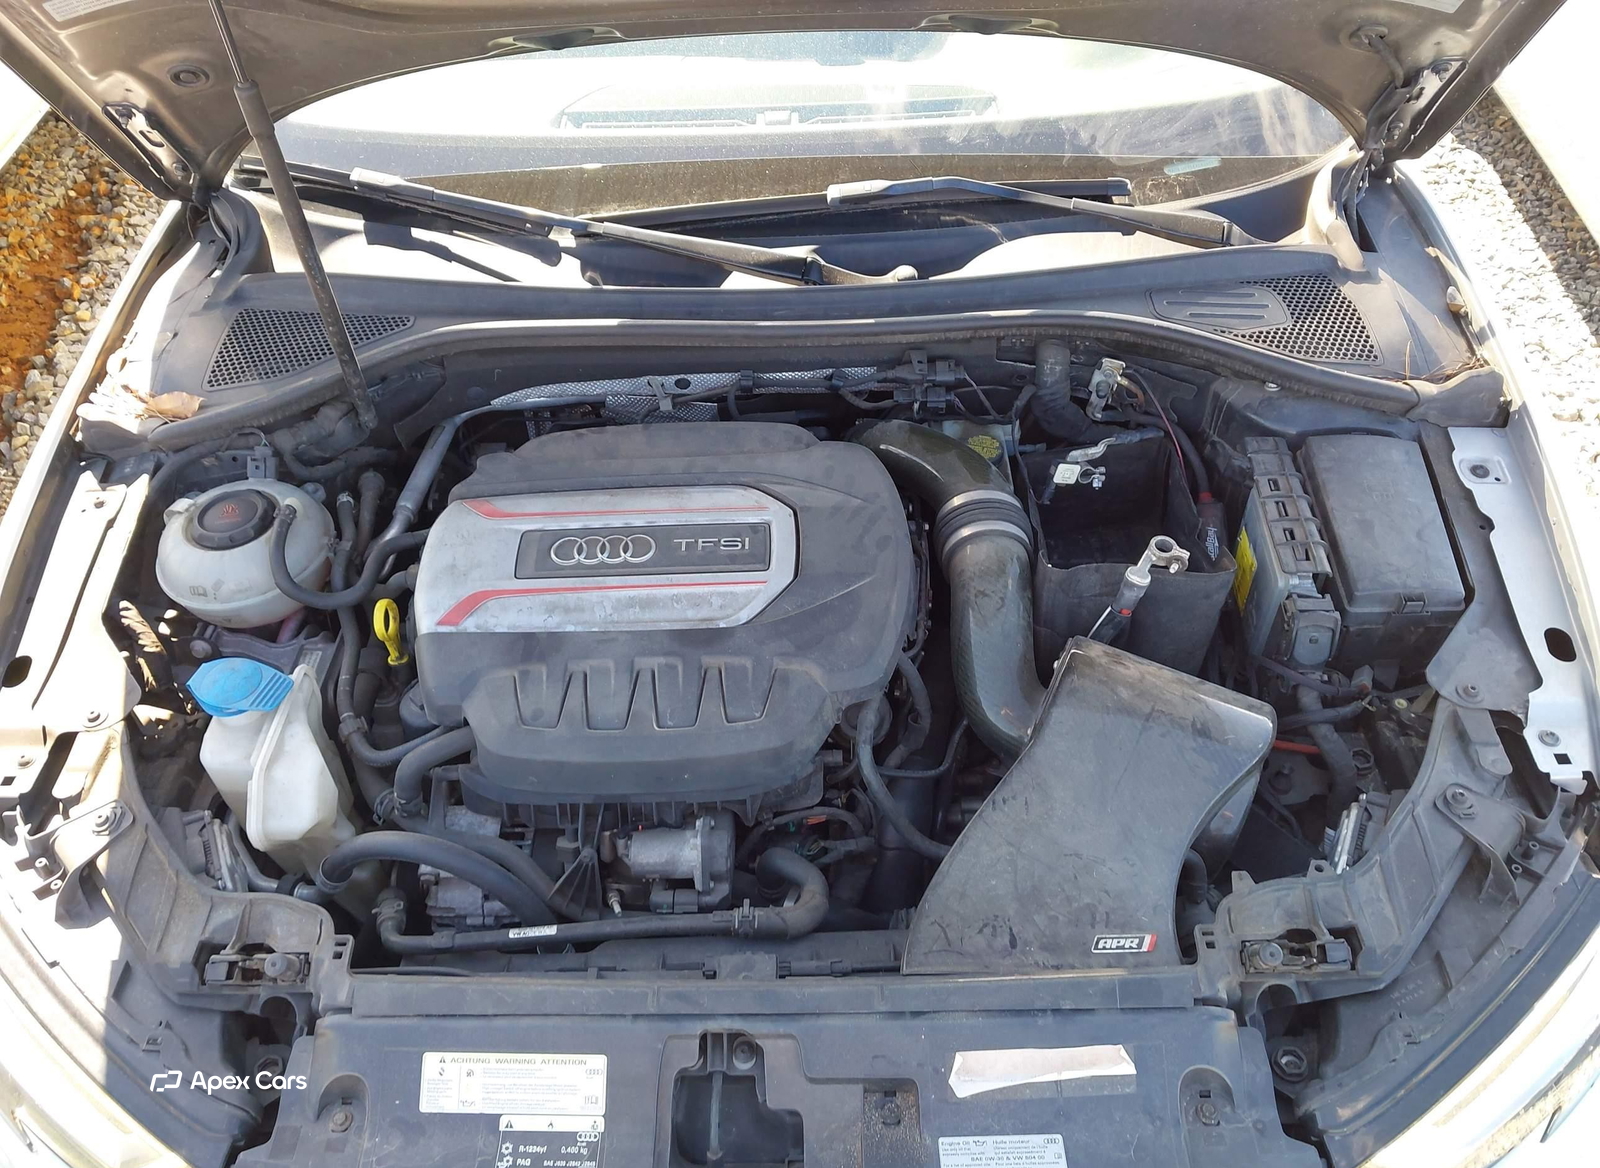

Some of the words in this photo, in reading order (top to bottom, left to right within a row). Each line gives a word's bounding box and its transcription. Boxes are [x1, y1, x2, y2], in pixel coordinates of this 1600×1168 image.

[673, 537, 750, 552] TFSI
[1098, 938, 1140, 948] APR
[518, 1145, 547, 1154] R-1234yf
[580, 1146, 588, 1155] kg
